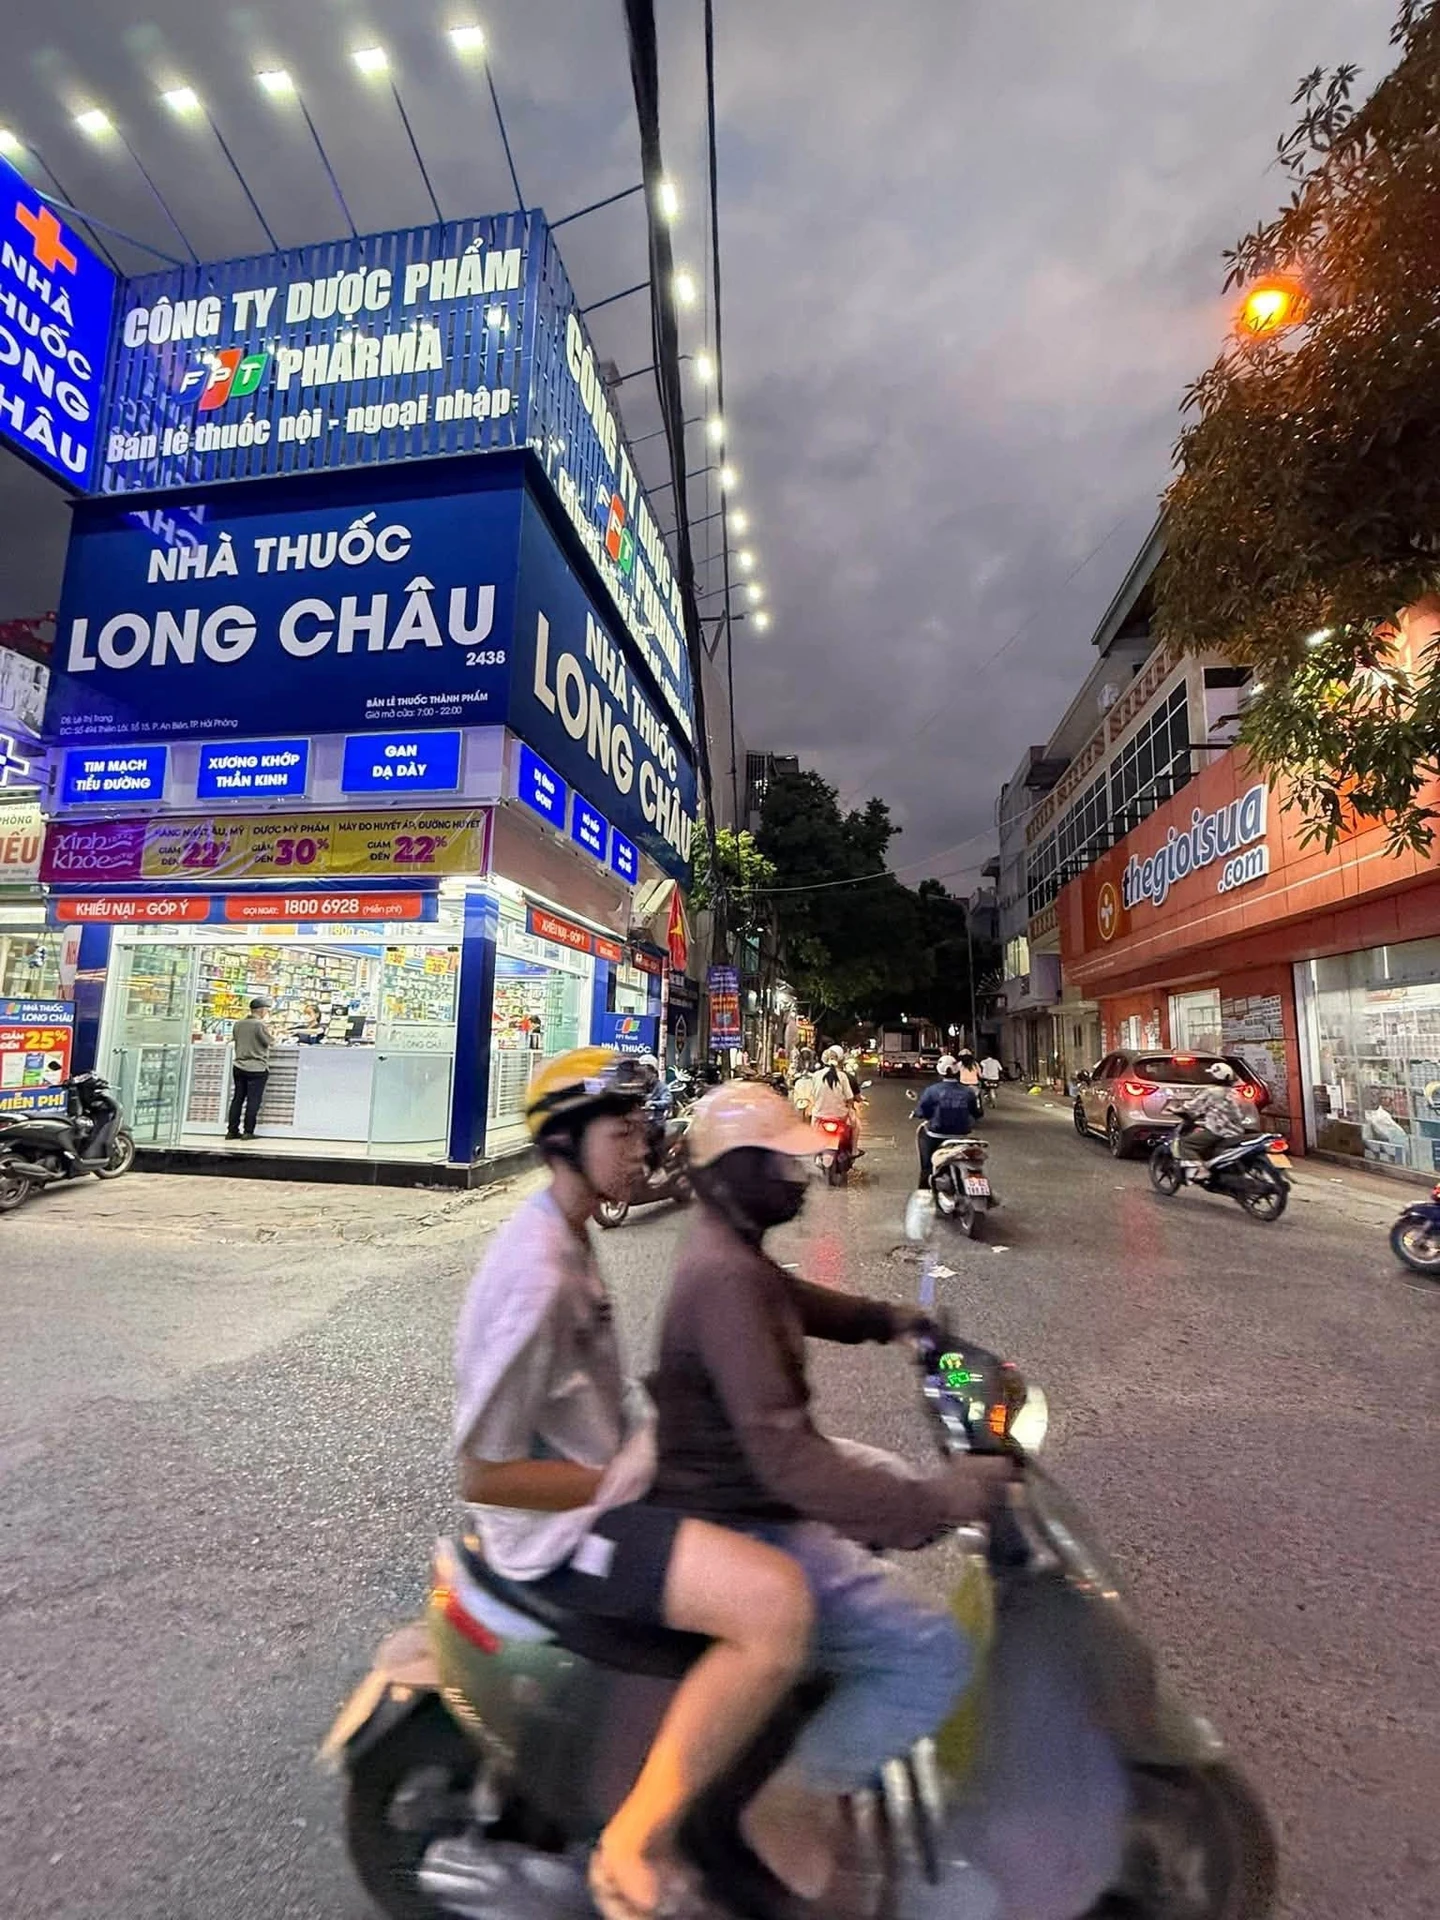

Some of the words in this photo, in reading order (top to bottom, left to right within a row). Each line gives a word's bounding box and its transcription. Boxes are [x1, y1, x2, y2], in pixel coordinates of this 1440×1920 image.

[1, 240, 75, 328] NHÀ
[124, 296, 221, 348] CÔNG
[232, 287, 279, 331] TY
[285, 266, 391, 325] DƯỢC
[403, 237, 524, 306] PHẨM
[0, 282, 92, 381] HUỐC
[276, 330, 442, 391] PHARMA
[0, 322, 91, 422] ONG
[566, 313, 617, 475] CÔNG
[0, 383, 88, 473] HÂU
[106, 426, 156, 464] Bán
[162, 423, 187, 457] lẻ
[195, 406, 270, 451] thuốc
[278, 409, 321, 444] nội
[346, 393, 428, 434] ngoại
[436, 389, 511, 421] nhập
[147, 531, 239, 584] NHÀ
[254, 511, 412, 575] THUỐC
[67, 604, 258, 673] LONG
[279, 576, 496, 658] CHÂU
[466, 650, 506, 666] 2438
[366, 697, 385, 708] BÁN
[397, 693, 427, 706] THUỐC
[430, 692, 460, 704] THÀNH
[586, 611, 629, 714] NHÀ
[632, 685, 678, 782] THUỐC
[417, 707, 434, 717] 7:00
[440, 706, 462, 715] 22:00
[534, 610, 634, 795] LONG
[638, 760, 692, 864] CHÂU
[208, 755, 259, 769] XƯƠNG
[261, 751, 300, 767] KHỚP
[385, 744, 418, 758] GAN
[84, 761, 105, 773] TIM
[107, 759, 148, 774] MẠCH
[372, 764, 393, 781] DẠ
[397, 763, 427, 778] DÀY
[76, 774, 101, 791] TIỂU
[103, 774, 151, 790] ĐƯỜNG
[254, 773, 288, 786] KINH
[0, 813, 32, 825] HÒNG
[253, 824, 281, 836] DƯỢC
[300, 821, 330, 833] PHẨM
[338, 821, 357, 832] MÁY
[359, 822, 373, 831] ĐO
[374, 819, 401, 831] HUYẾT
[452, 817, 480, 829] HUYẾT
[1122, 783, 1268, 911] thegioisua
[370, 851, 390, 863] ĐẾN
[1217, 844, 1269, 893] .com
[76, 898, 111, 916] KHIẾU
[112, 902, 135, 919] NẠI
[146, 899, 177, 915] GÓP
[177, 898, 189, 915] Ý
[242, 906, 257, 918] GỌI
[284, 899, 318, 914] 1800
[321, 899, 360, 914] 6928
[21, 1014, 48, 1022] LONG
[49, 1012, 74, 1022] CHÂU
[24, 1029, 68, 1049] 25%
[621, 1043, 651, 1054] THUỐC
[38, 1091, 65, 1107] PHÍ
